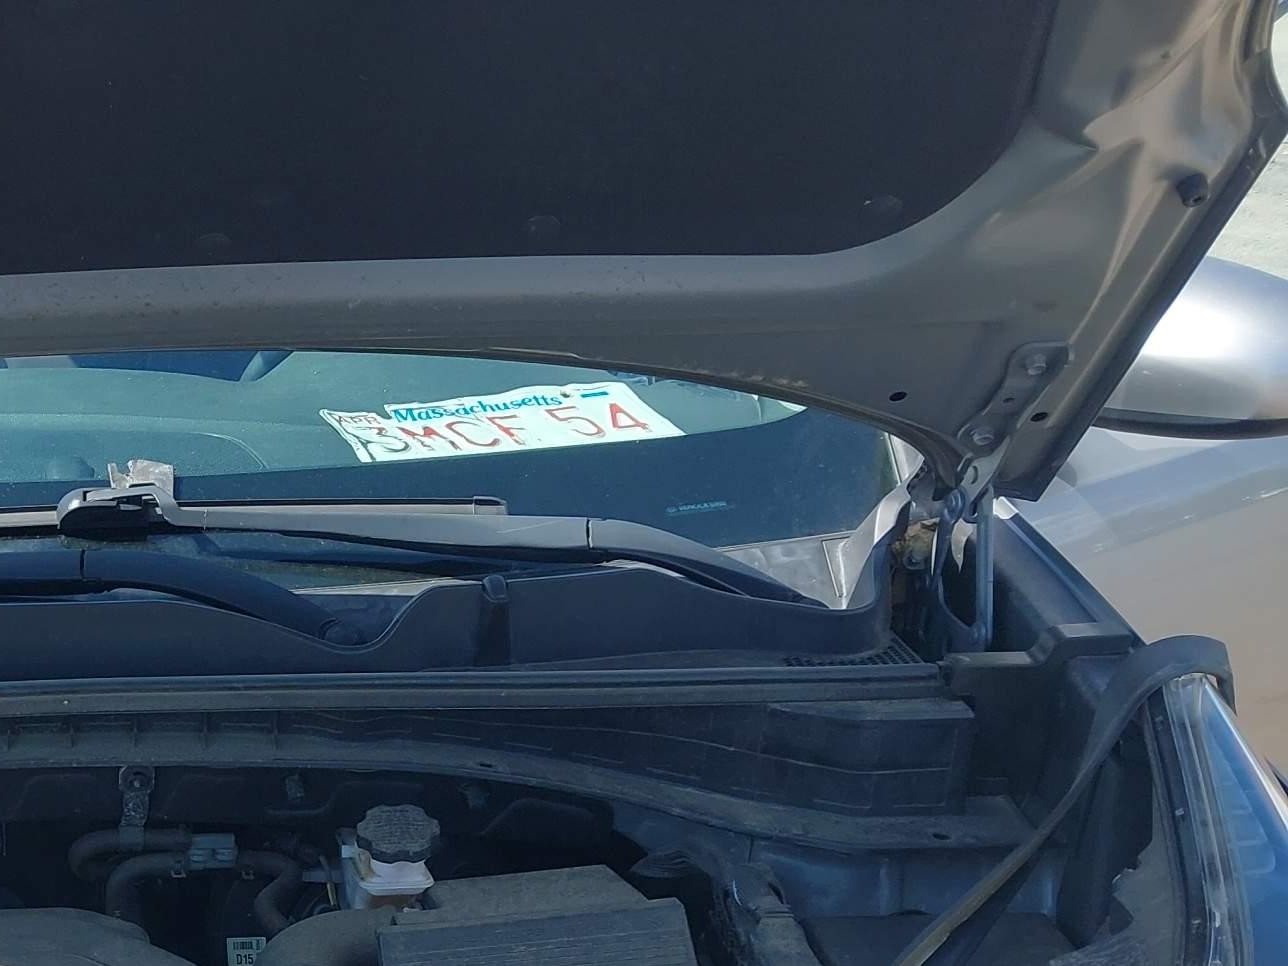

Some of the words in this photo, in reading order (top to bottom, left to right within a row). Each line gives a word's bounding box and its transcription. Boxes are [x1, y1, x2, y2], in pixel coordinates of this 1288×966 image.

[391, 394, 562, 423] Massachusetts
[353, 414, 527, 453] 3MCF
[544, 402, 652, 439] 54
[236, 953, 254, 965] D15
